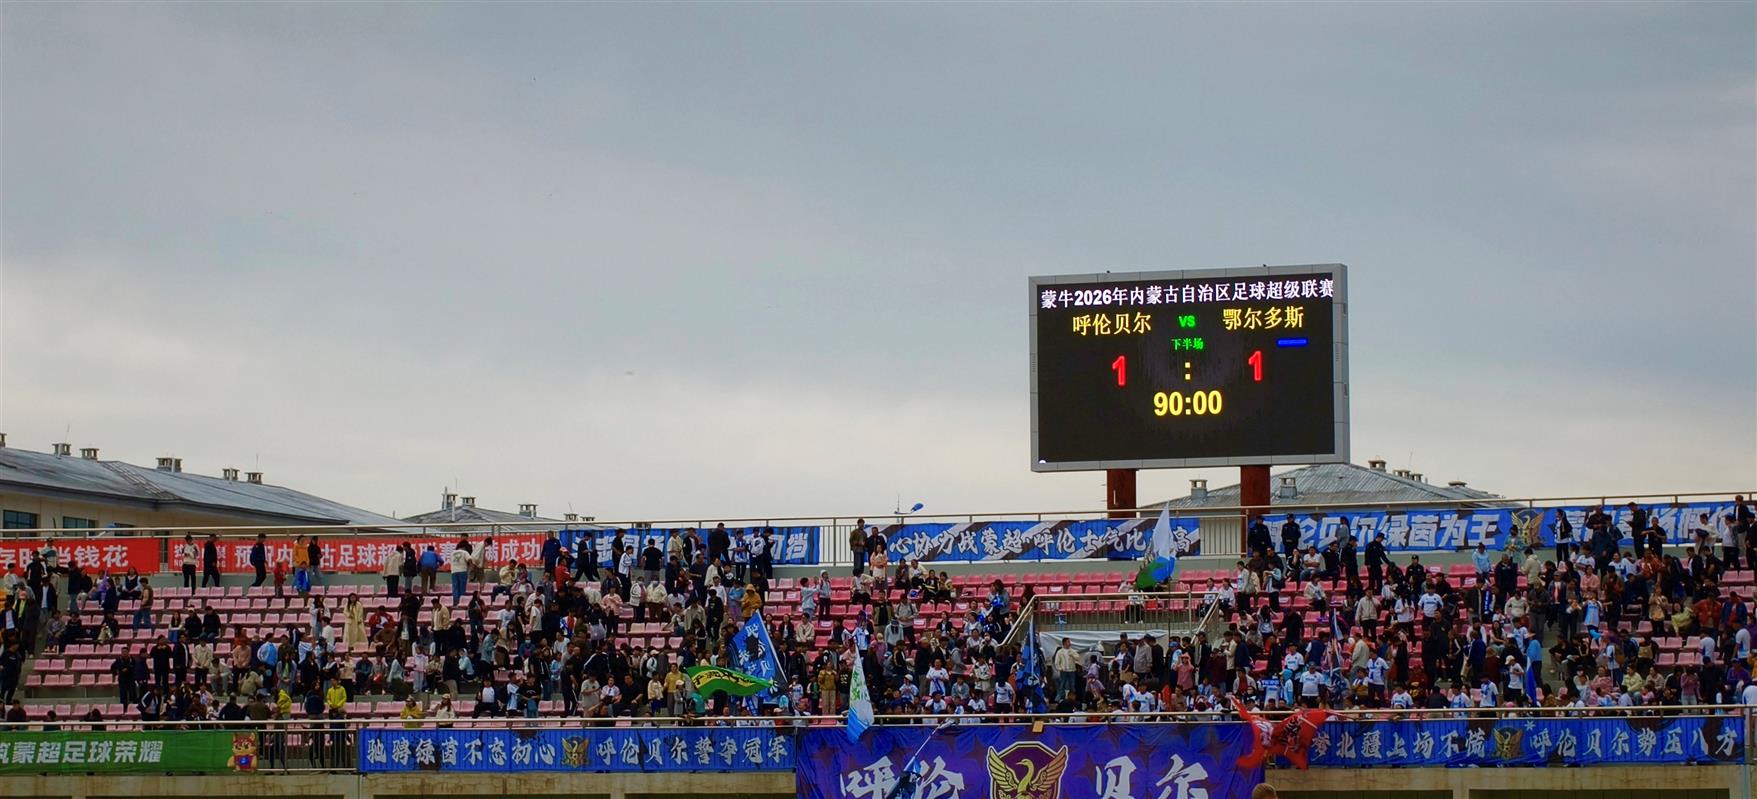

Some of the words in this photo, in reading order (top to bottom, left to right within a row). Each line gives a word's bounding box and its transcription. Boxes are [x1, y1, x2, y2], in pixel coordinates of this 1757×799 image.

[1041, 279, 1334, 309] 蒙牛2026年内蒙古自治区足球超级联赛
[1072, 311, 1152, 336] 呼伦贝尔
[1222, 306, 1305, 331] 鄂尔多斯
[1171, 338, 1204, 351] 下半场
[1111, 355, 1127, 386] 1
[1248, 350, 1263, 382] 1
[1153, 390, 1223, 417] 90:00
